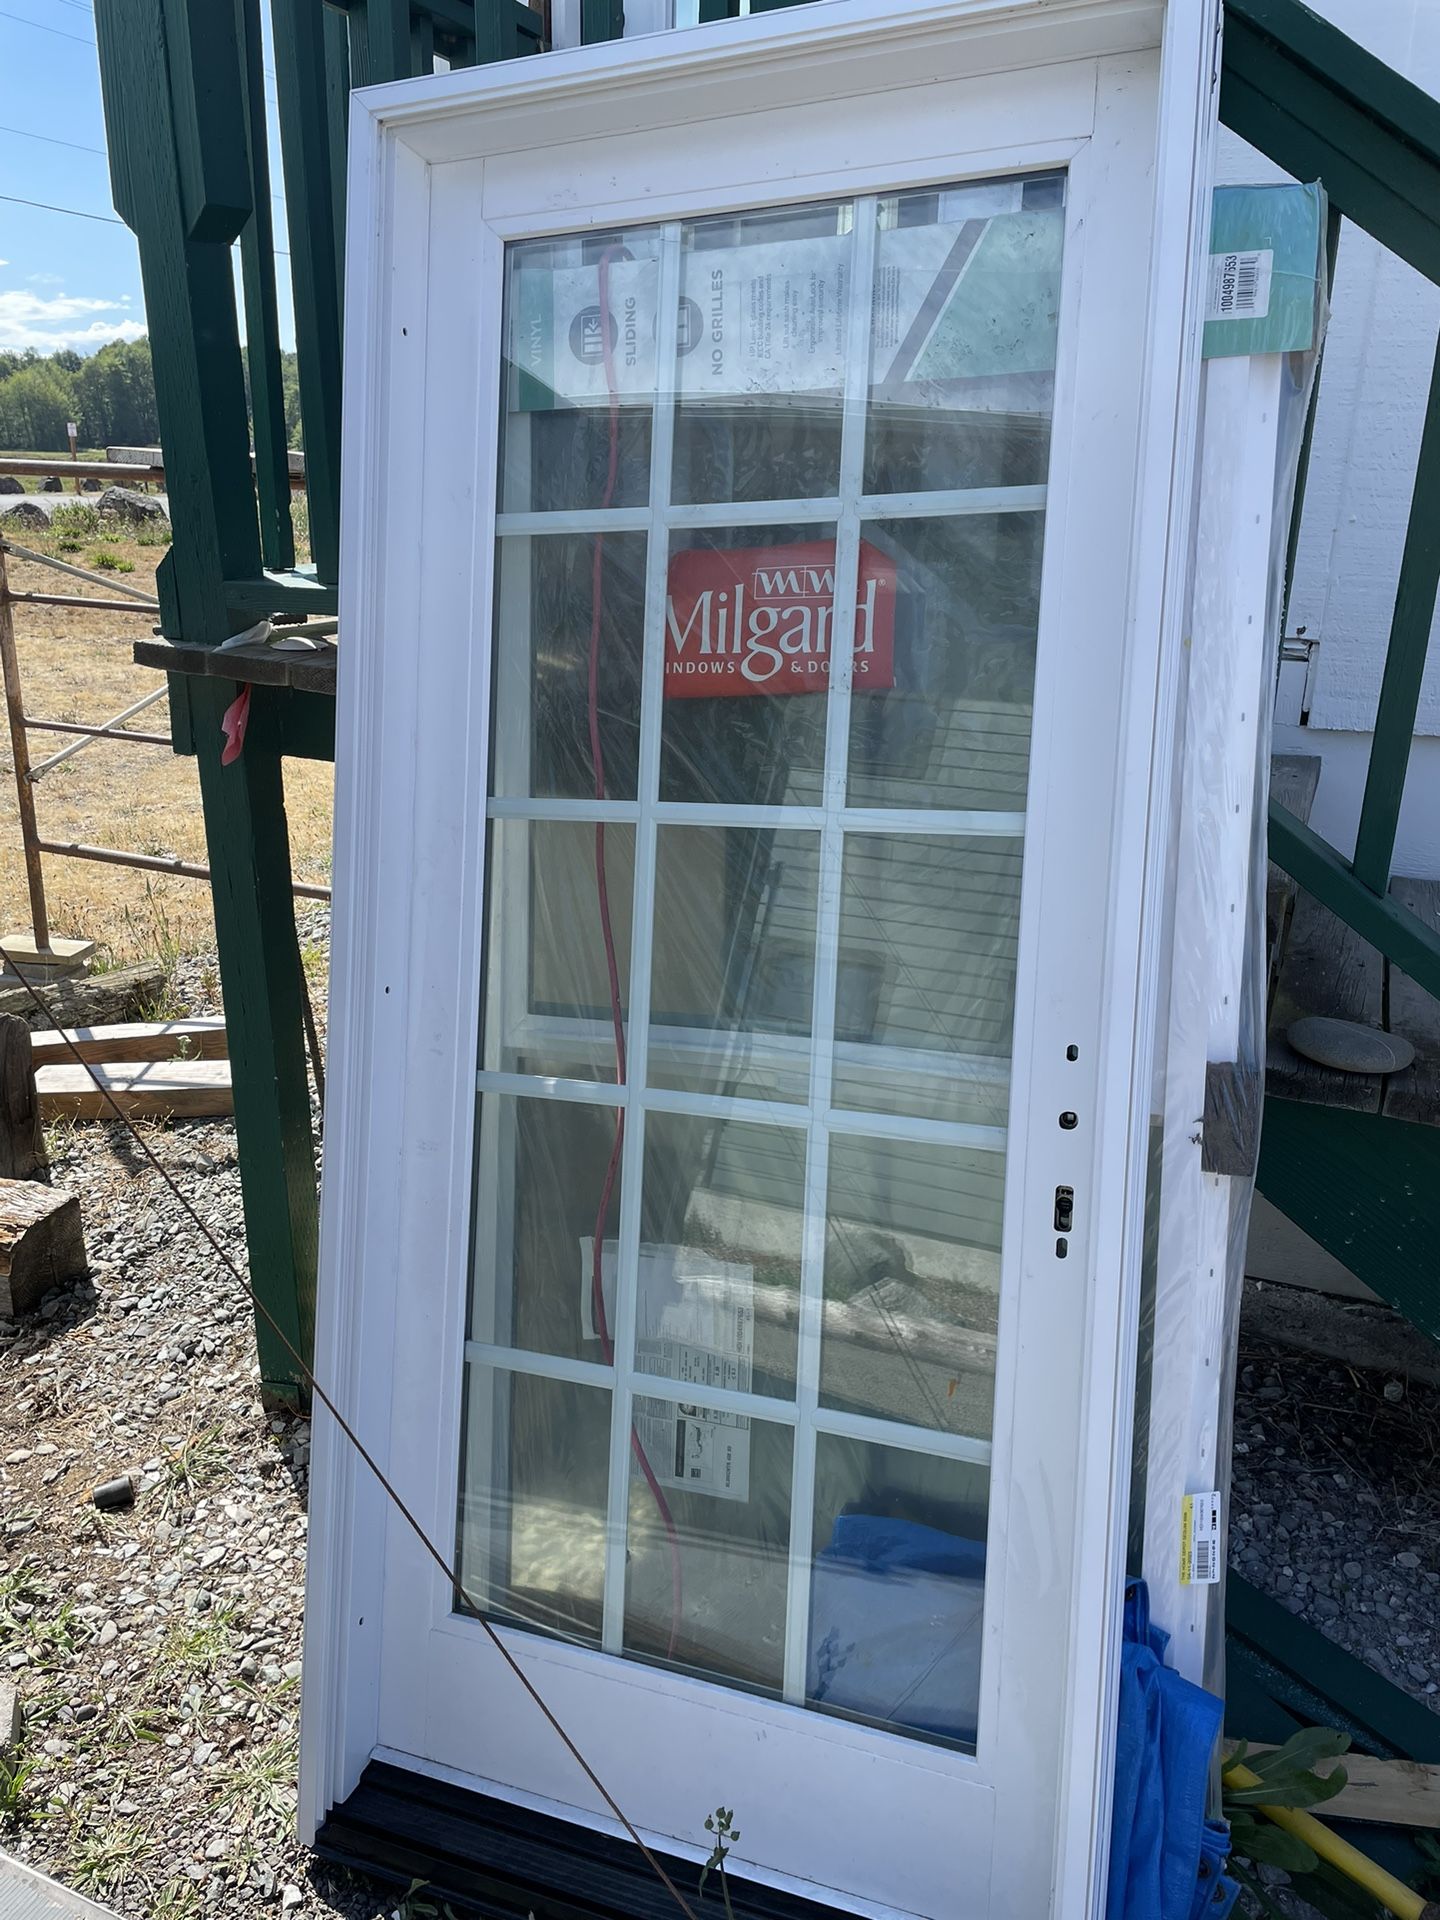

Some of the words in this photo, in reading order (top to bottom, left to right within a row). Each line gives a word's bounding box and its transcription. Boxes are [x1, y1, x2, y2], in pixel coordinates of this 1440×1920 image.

[625, 296, 637, 367] SLIDING
[711, 269, 723, 343] GRILLES
[530, 312, 543, 367] VINYL
[711, 350, 723, 376] NO
[666, 579, 877, 682] Milgard
[666, 660, 736, 675] INDOWS
[790, 660, 804, 674] &
